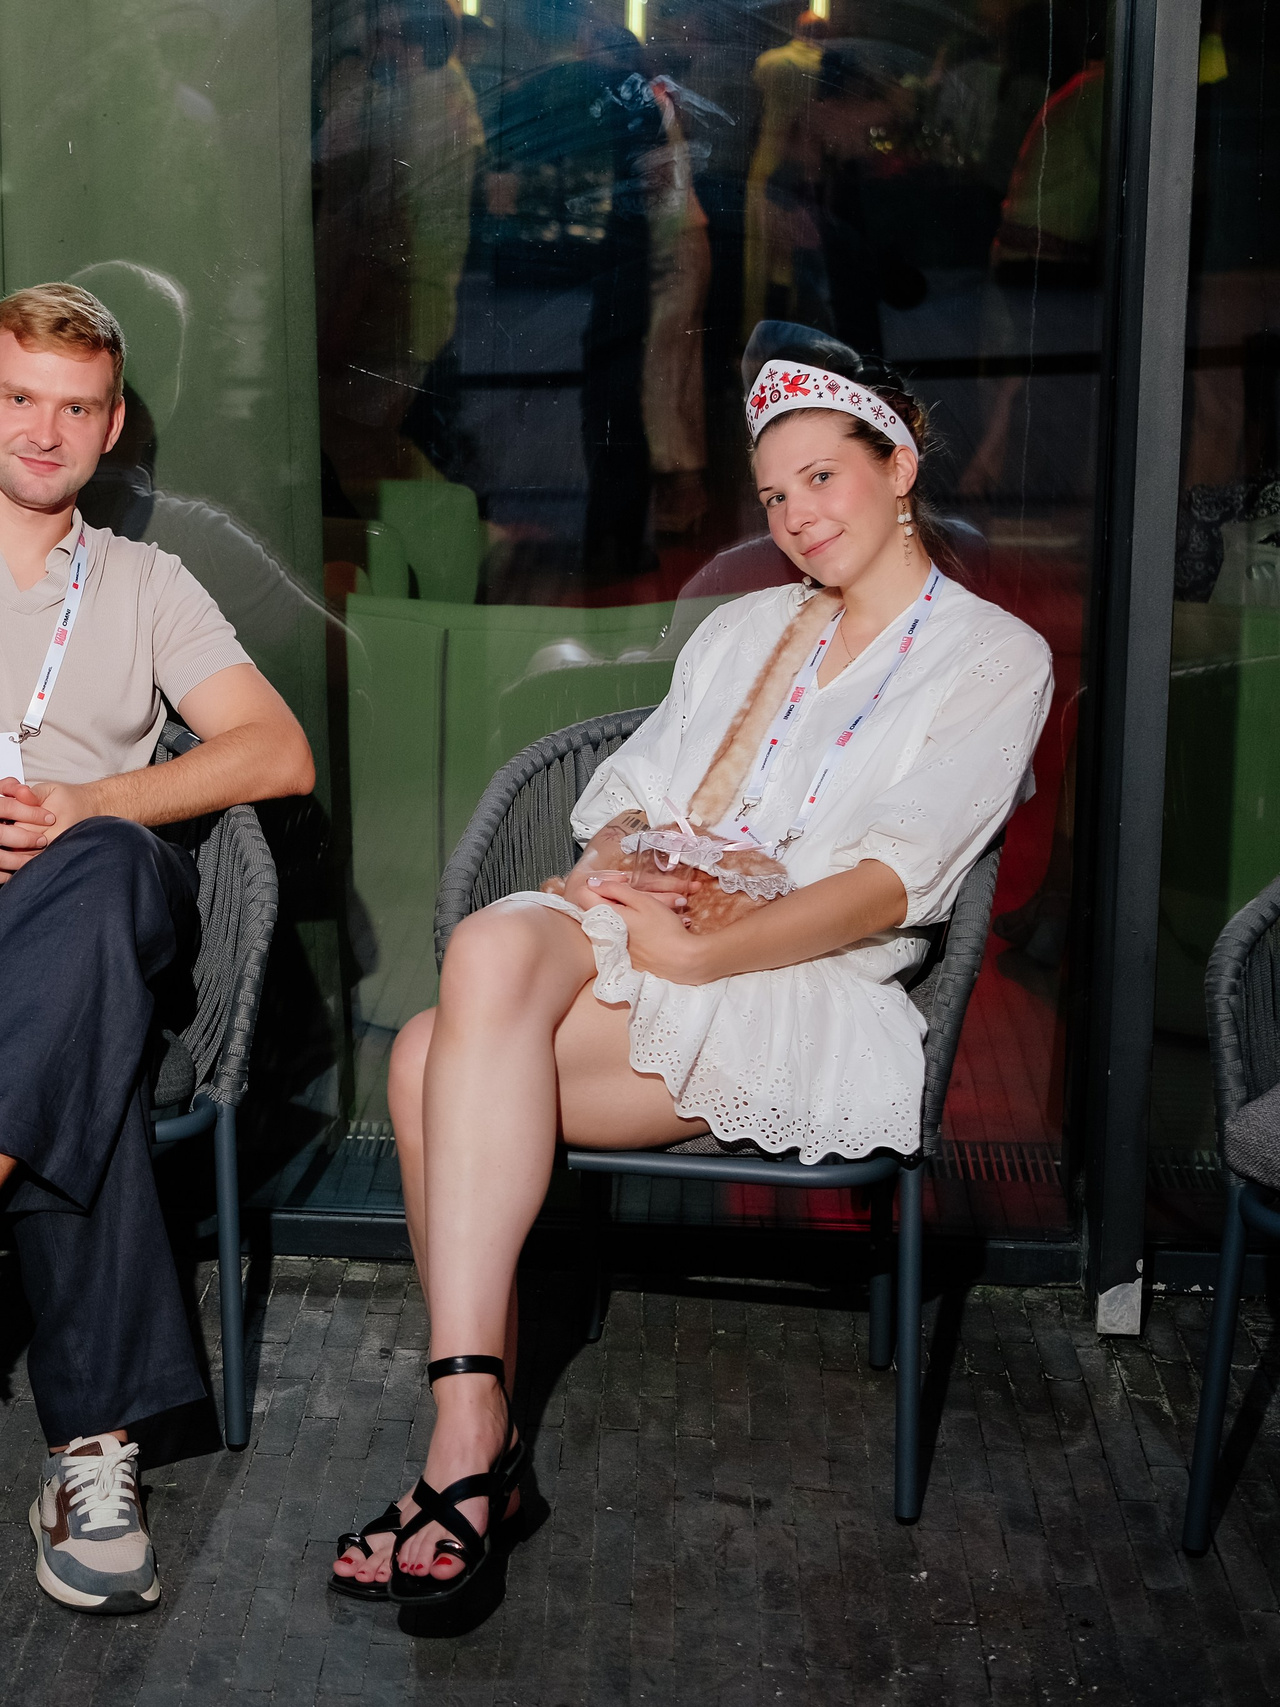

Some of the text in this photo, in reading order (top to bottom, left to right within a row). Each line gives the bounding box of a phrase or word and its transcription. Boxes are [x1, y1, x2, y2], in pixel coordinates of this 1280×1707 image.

[62, 608, 71, 627] OMNI
[908, 618, 919, 635] OMNI
[783, 704, 795, 720] OMNI
